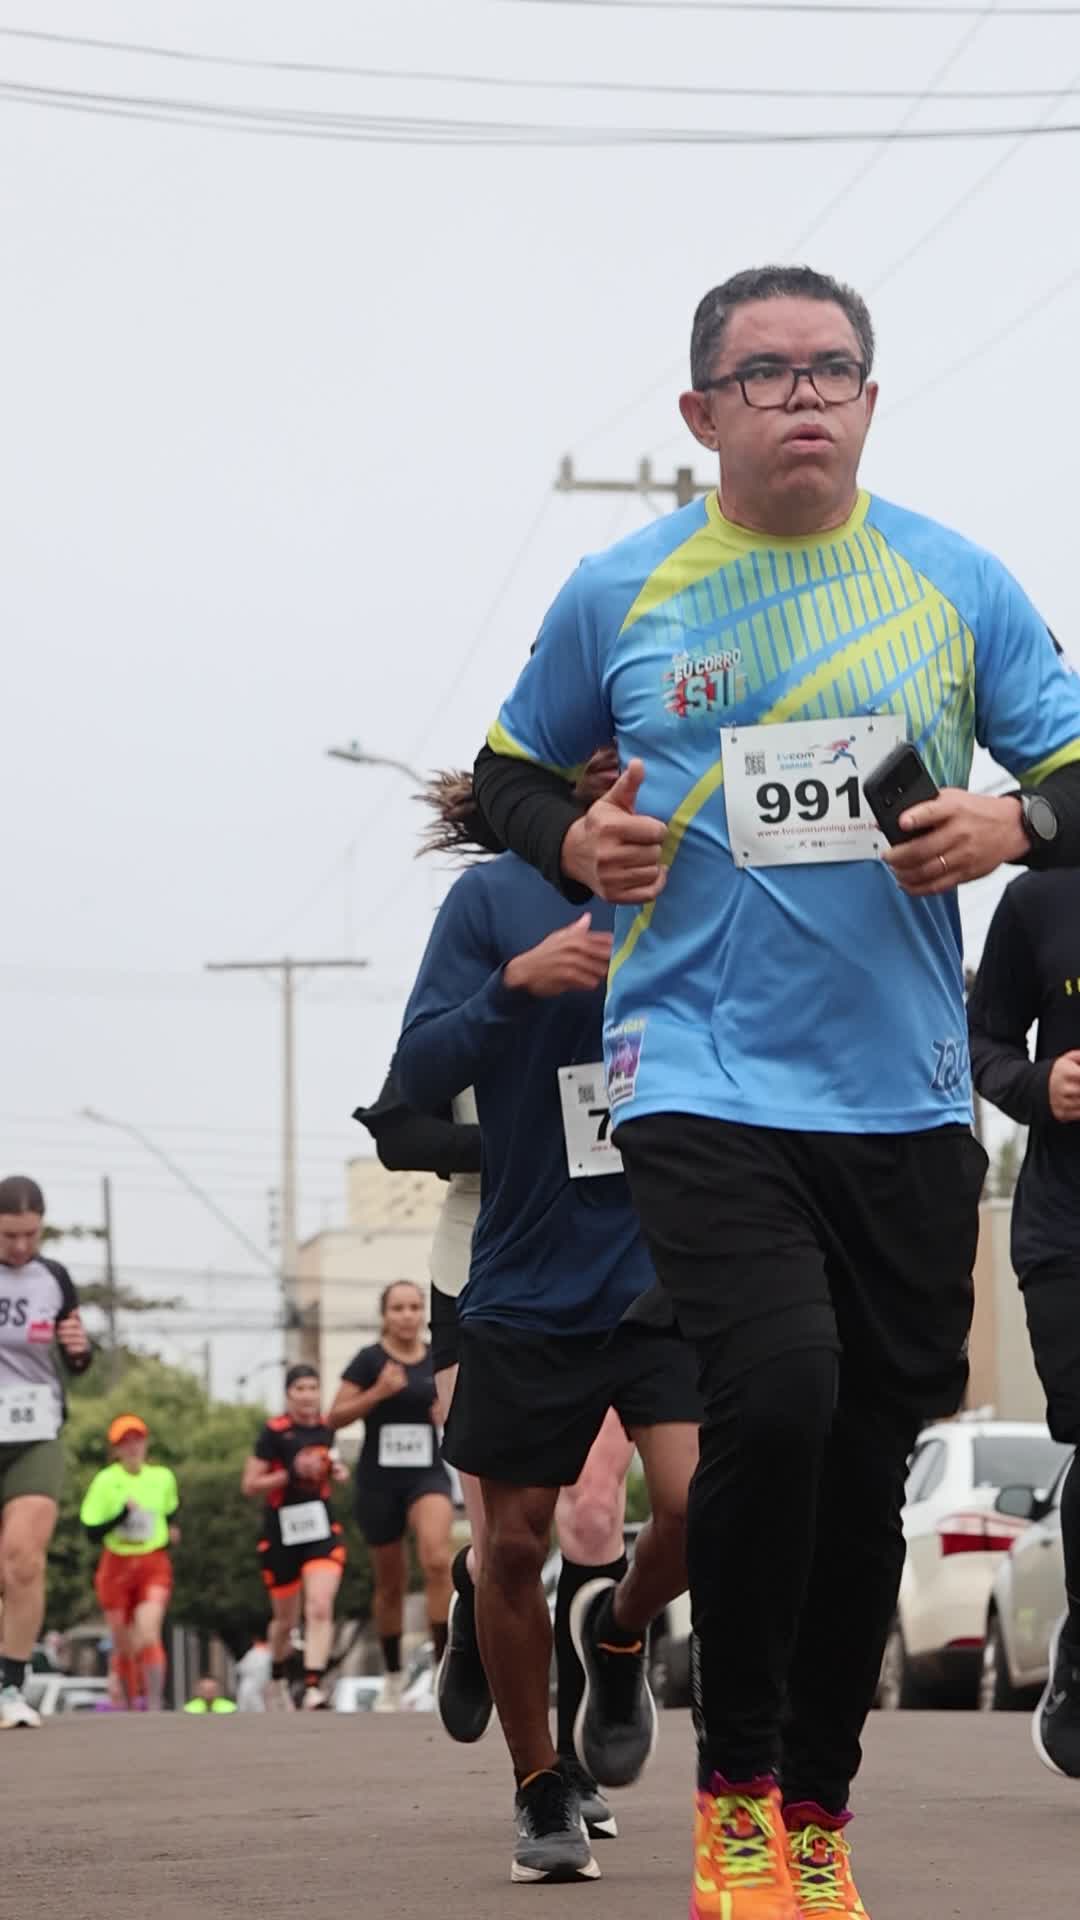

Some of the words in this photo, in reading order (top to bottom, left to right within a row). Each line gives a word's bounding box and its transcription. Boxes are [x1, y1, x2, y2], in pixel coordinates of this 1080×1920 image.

[674, 660, 694, 683] EU
[695, 648, 742, 675] CORRO
[756, 775, 861, 824] 991
